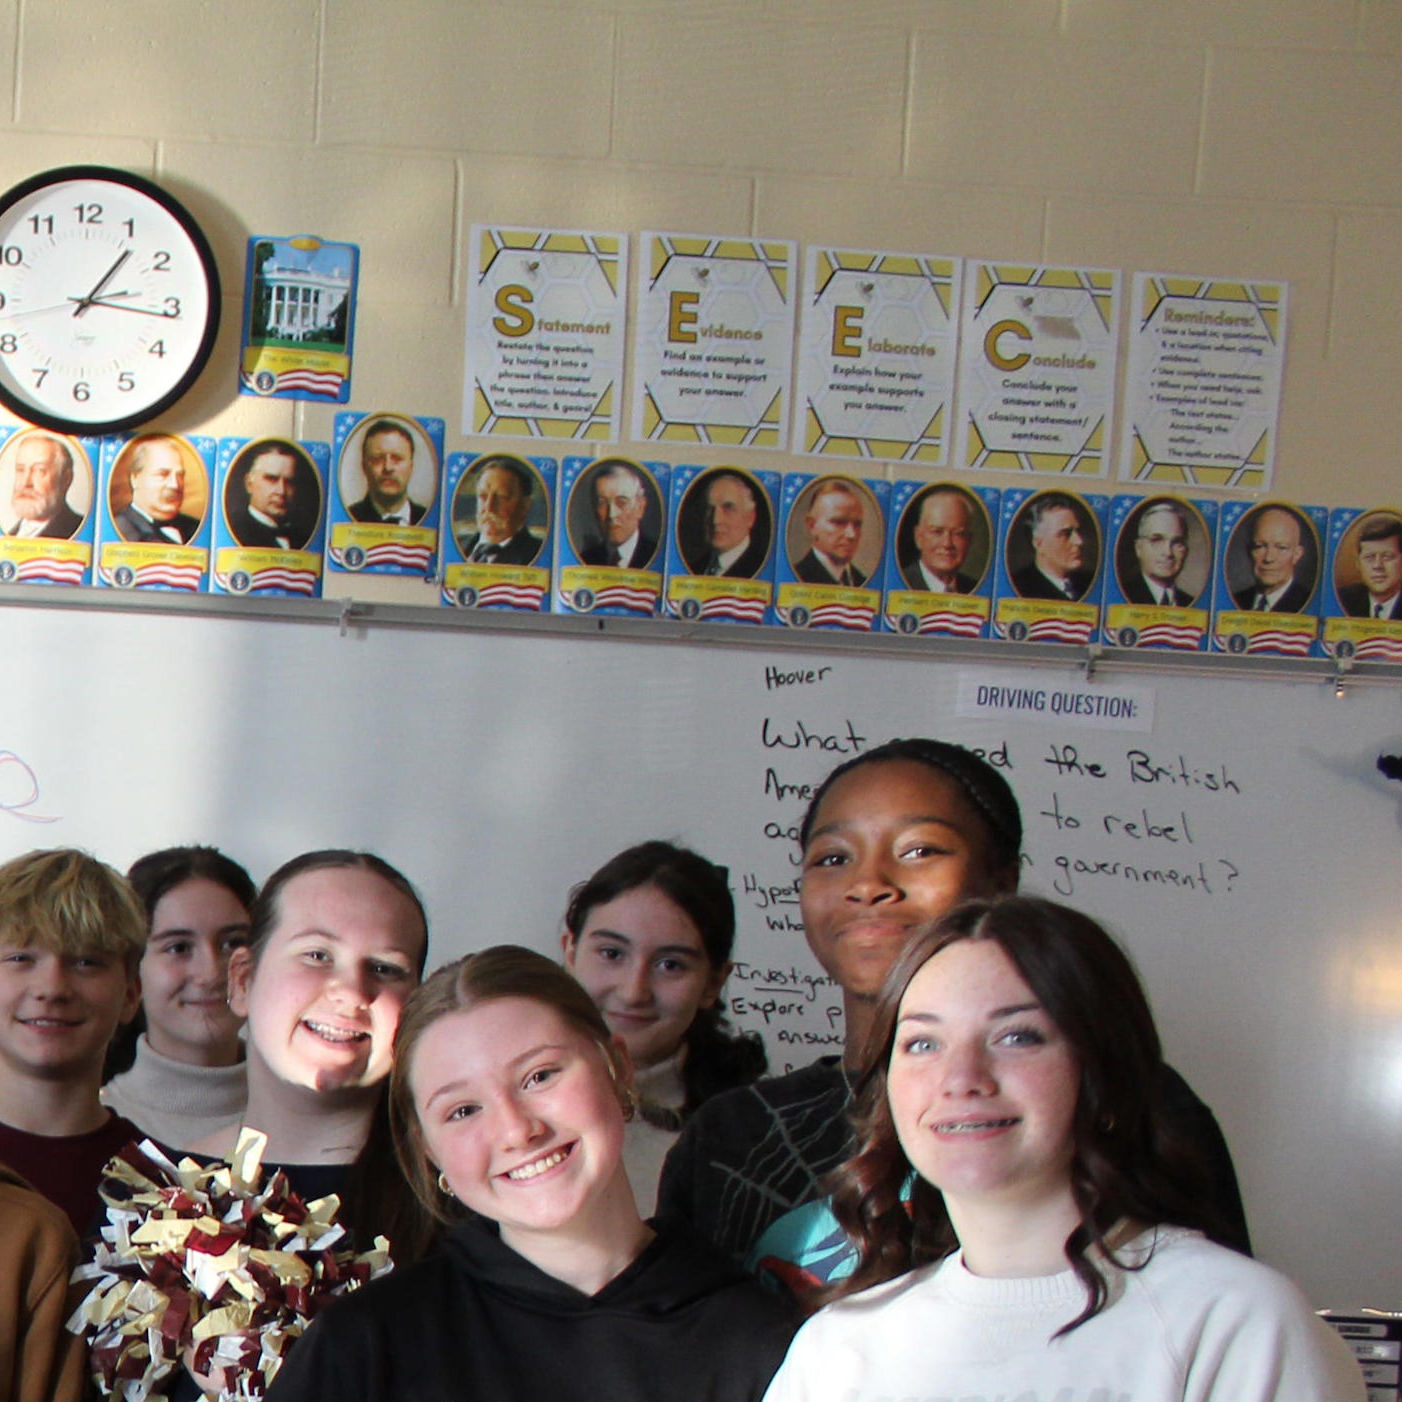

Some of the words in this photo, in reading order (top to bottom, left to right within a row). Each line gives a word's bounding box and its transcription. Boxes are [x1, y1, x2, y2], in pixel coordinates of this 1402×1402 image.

[28, 214, 55, 235] 11
[73, 203, 104, 225] 12
[122, 217, 135, 238] 1
[152, 251, 172, 272] 2
[163, 297, 181, 319] 3
[0, 333, 18, 354] 8
[148, 340, 167, 359] 4
[32, 369, 49, 389] 7
[117, 372, 136, 391] 5
[73, 382, 91, 402] 6
[764, 665, 833, 690] Hoover
[976, 685, 1047, 712] DRIVING
[1050, 691, 1140, 719] QUESTION:
[761, 717, 866, 756] What
[1044, 745, 1107, 779] the
[1126, 749, 1241, 795] British
[1040, 796, 1080, 830] to
[1103, 807, 1194, 844] rebel
[731, 997, 805, 1024] Explore
